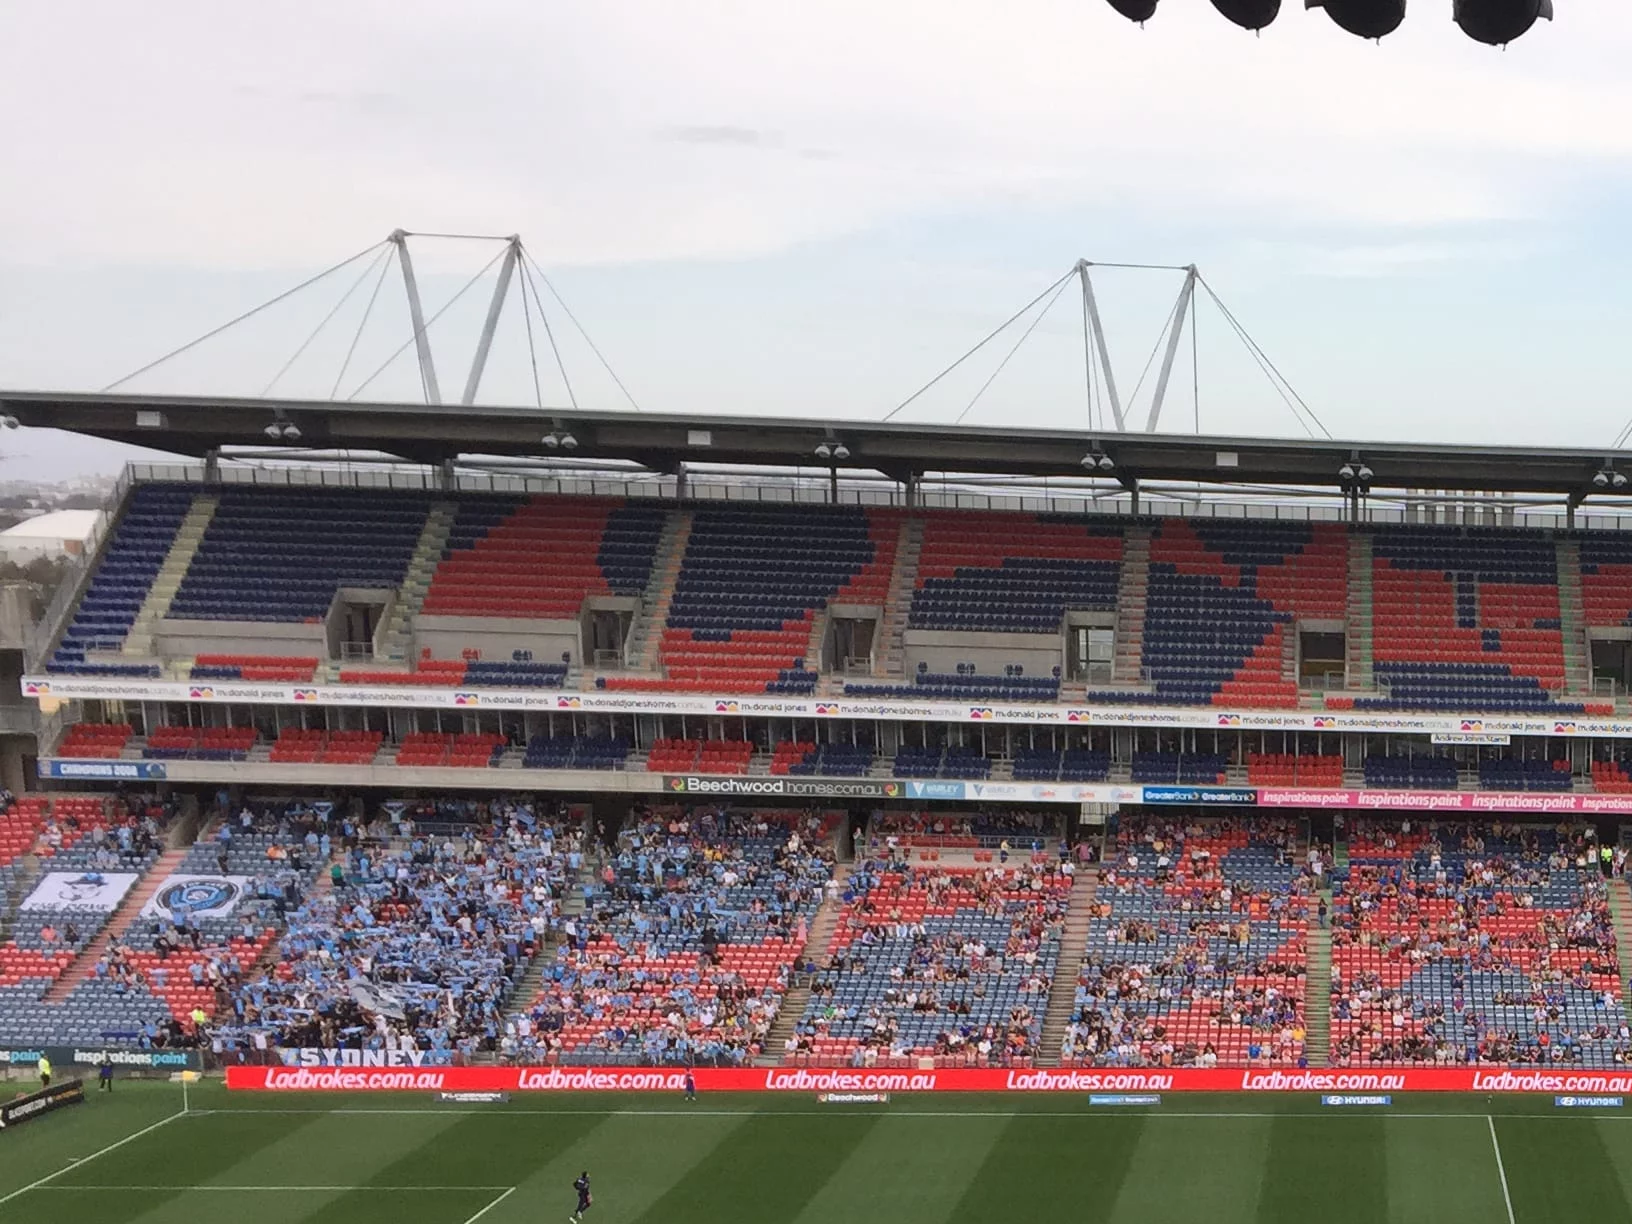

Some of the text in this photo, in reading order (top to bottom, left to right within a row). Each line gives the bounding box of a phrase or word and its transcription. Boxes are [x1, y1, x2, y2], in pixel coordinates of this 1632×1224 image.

[687, 777, 784, 793] Beechwood
[300, 1048, 425, 1067] SYDNEY
[264, 1067, 445, 1089] Ladbrokes.com.au
[765, 1069, 936, 1090] Ladbrokes.com.au
[1006, 1070, 1173, 1090] Ladbrokes.com.au
[1242, 1070, 1406, 1090] Ladbrokes.com.au
[1472, 1071, 1632, 1092] Ladbrokes.com.au
